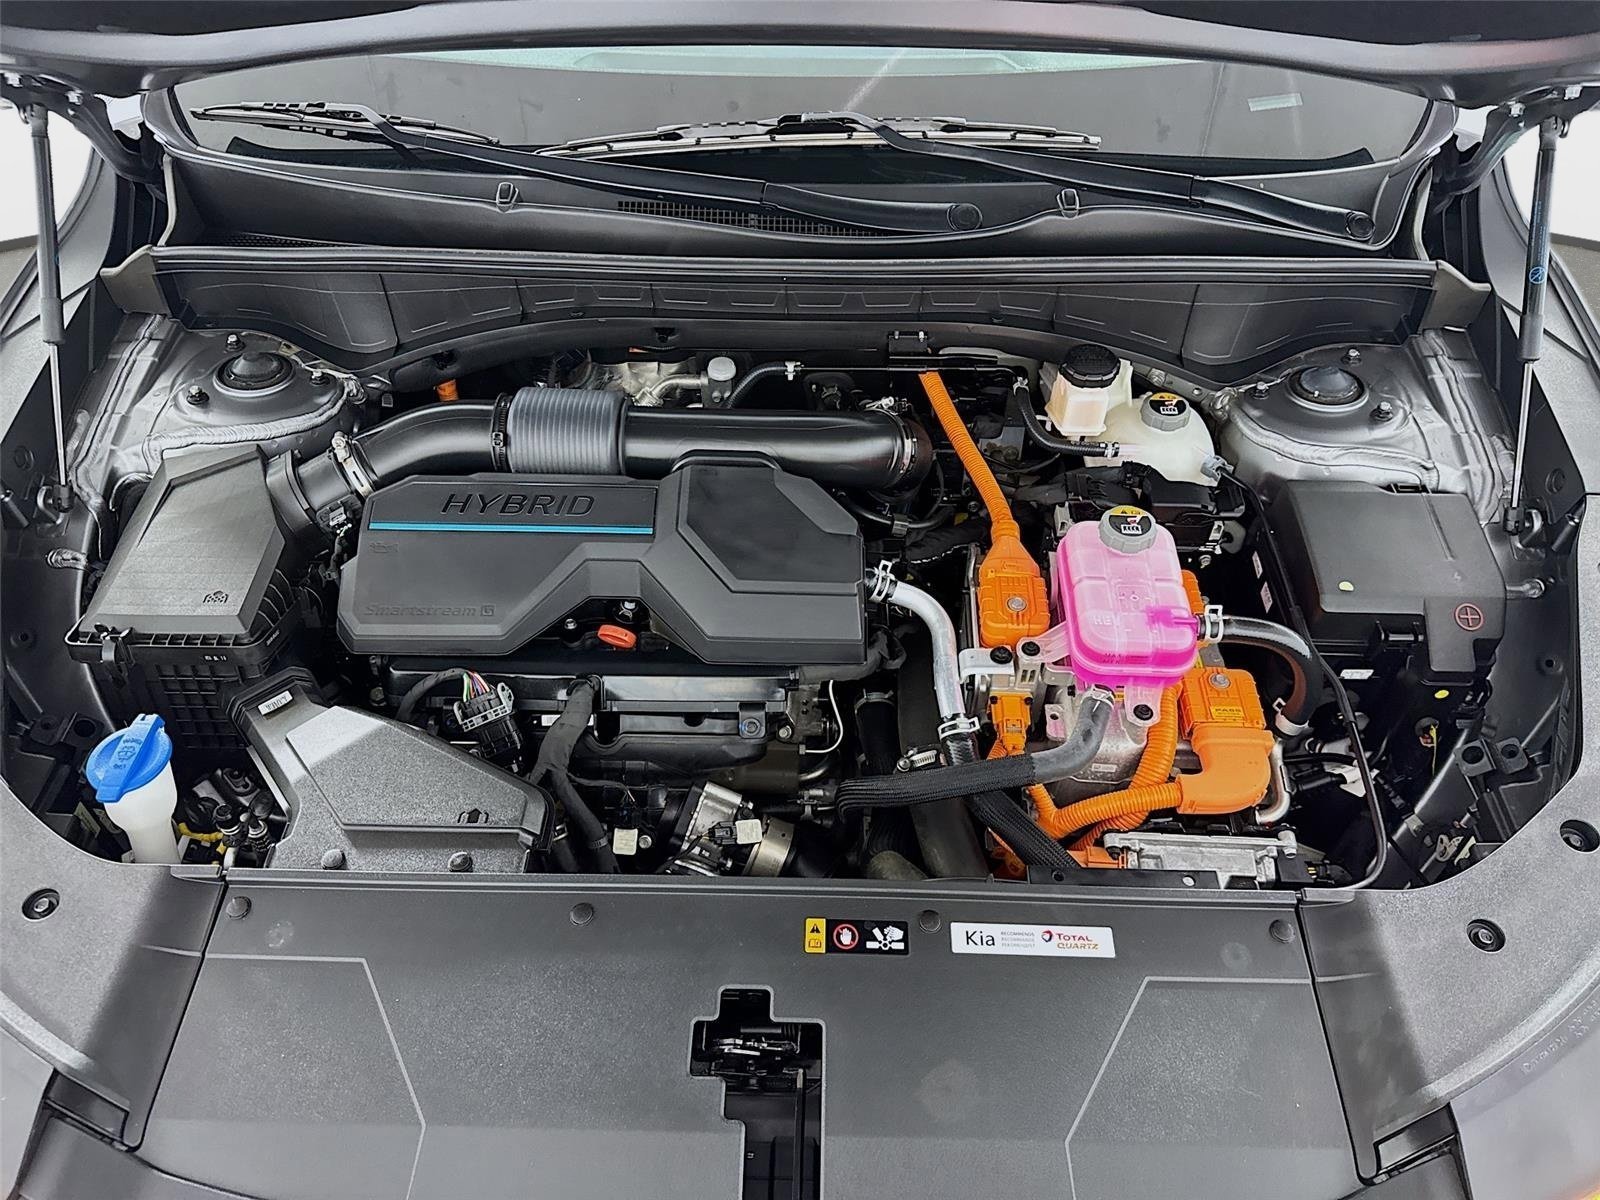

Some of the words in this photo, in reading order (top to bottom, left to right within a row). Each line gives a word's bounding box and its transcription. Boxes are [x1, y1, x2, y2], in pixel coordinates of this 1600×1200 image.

[440, 493, 595, 517] HYBRID
[363, 604, 477, 616] Smartstream
[965, 930, 996, 947] Kia
[1056, 933, 1093, 942] TOTAL
[1056, 942, 1099, 950] QUARTZ
